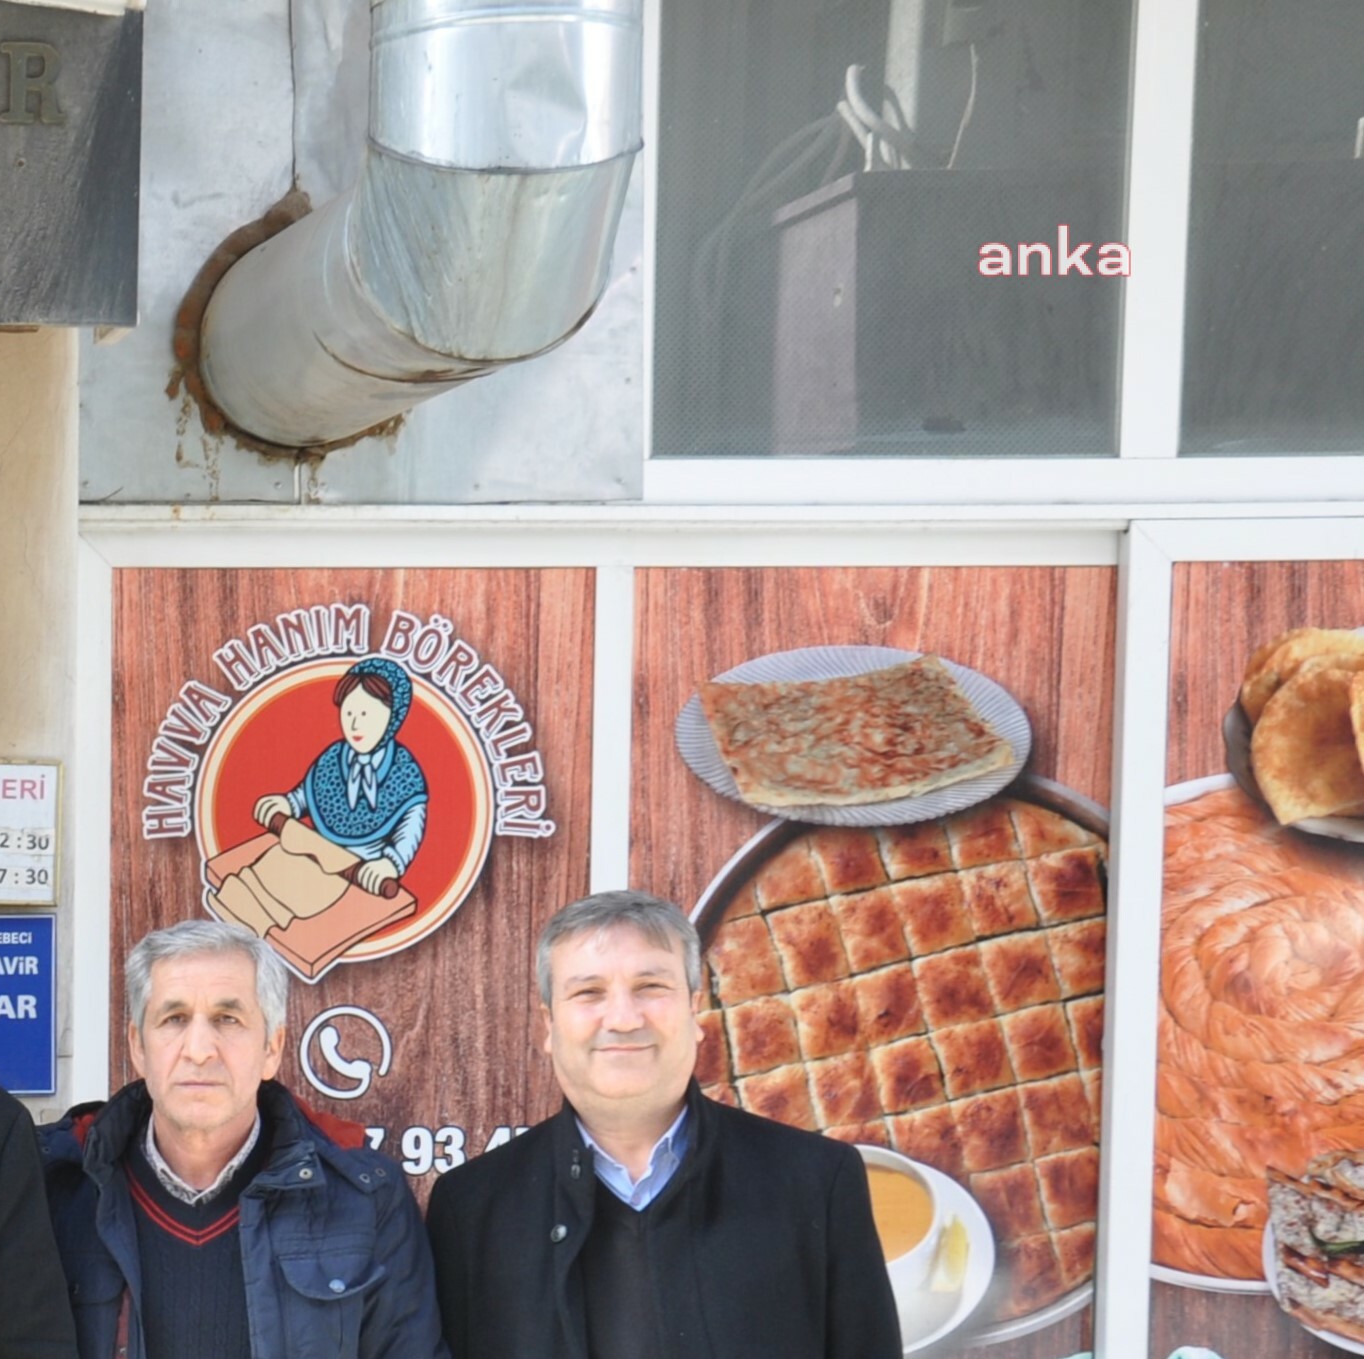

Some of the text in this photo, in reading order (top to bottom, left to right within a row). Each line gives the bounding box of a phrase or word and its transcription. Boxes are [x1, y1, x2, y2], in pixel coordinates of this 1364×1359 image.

[142, 603, 556, 841] HAVVA HANIM BÖREKLERİ
[401, 1125, 466, 1175] 93
